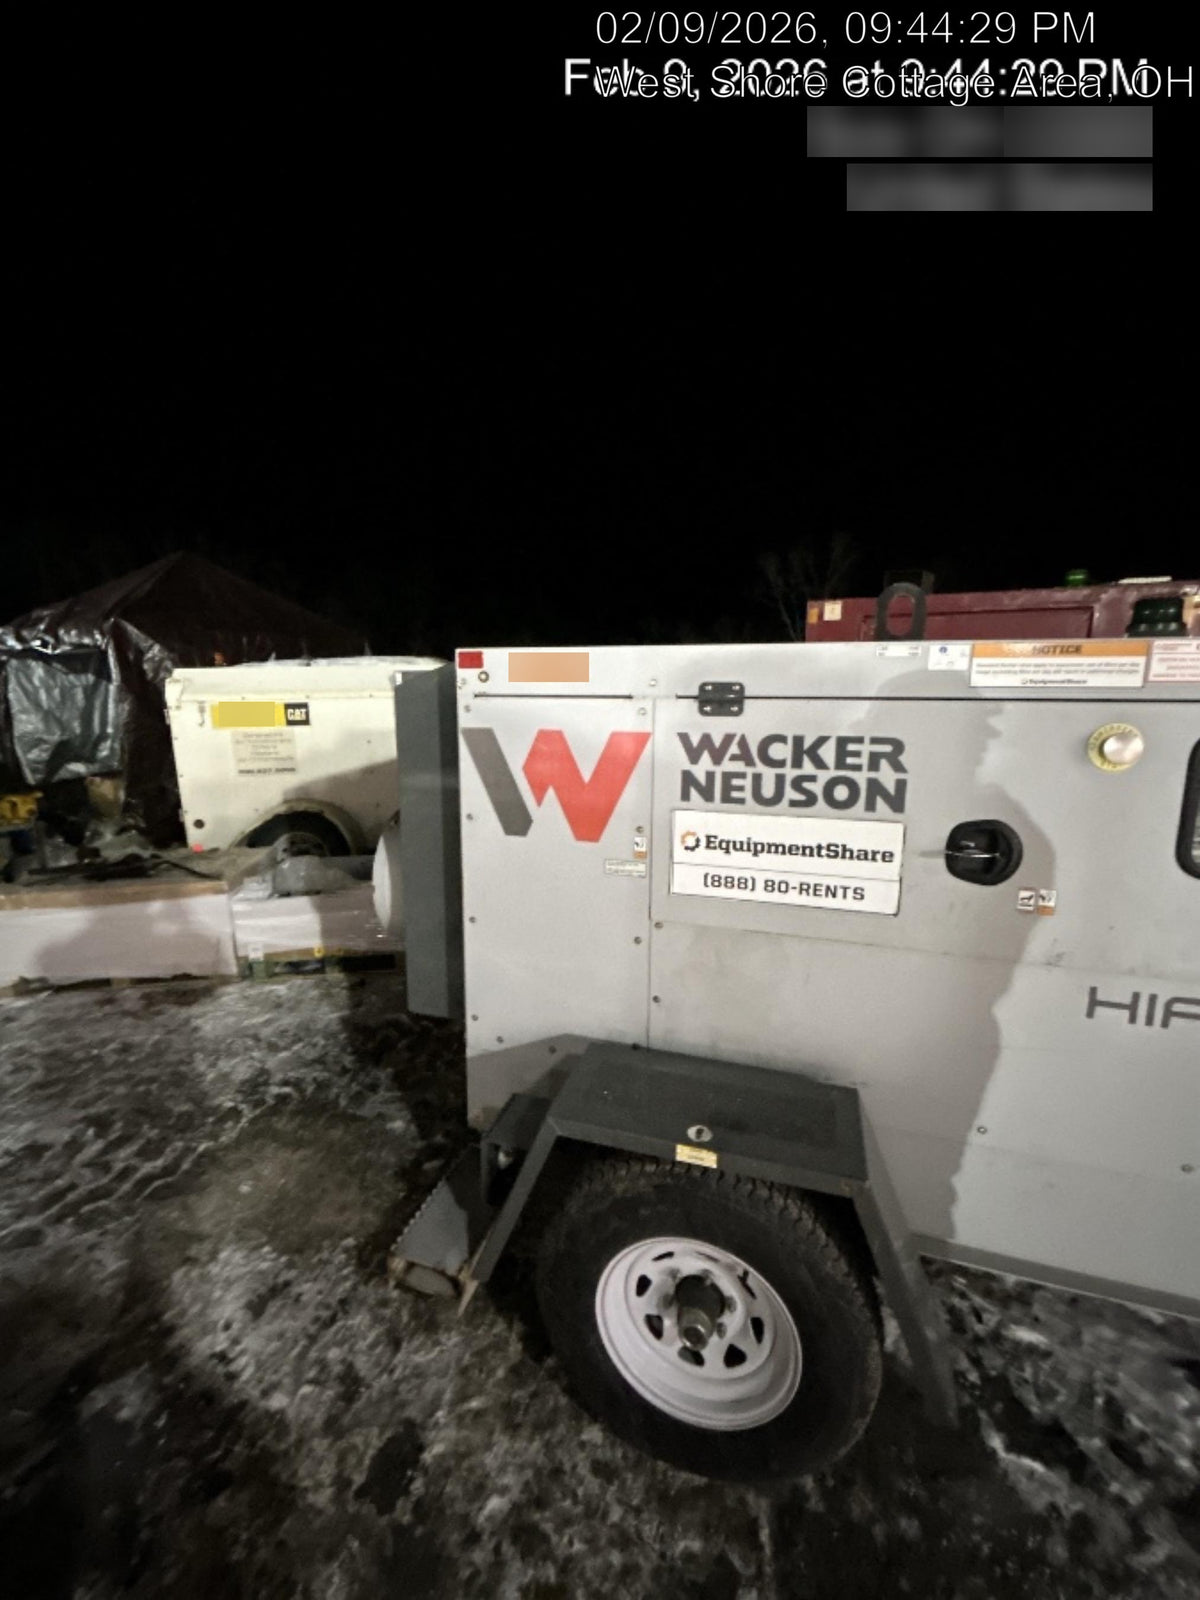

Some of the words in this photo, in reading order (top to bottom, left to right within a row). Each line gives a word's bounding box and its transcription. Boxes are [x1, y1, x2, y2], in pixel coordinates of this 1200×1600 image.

[1032, 644, 1082, 656] NOTICE
[287, 708, 306, 721] CAT
[677, 732, 908, 773] WACKER
[680, 769, 908, 813] NEUSON
[704, 834, 894, 864] EquipmentShare
[703, 873, 757, 891] (888)
[764, 879, 866, 901] 80-RENTS
